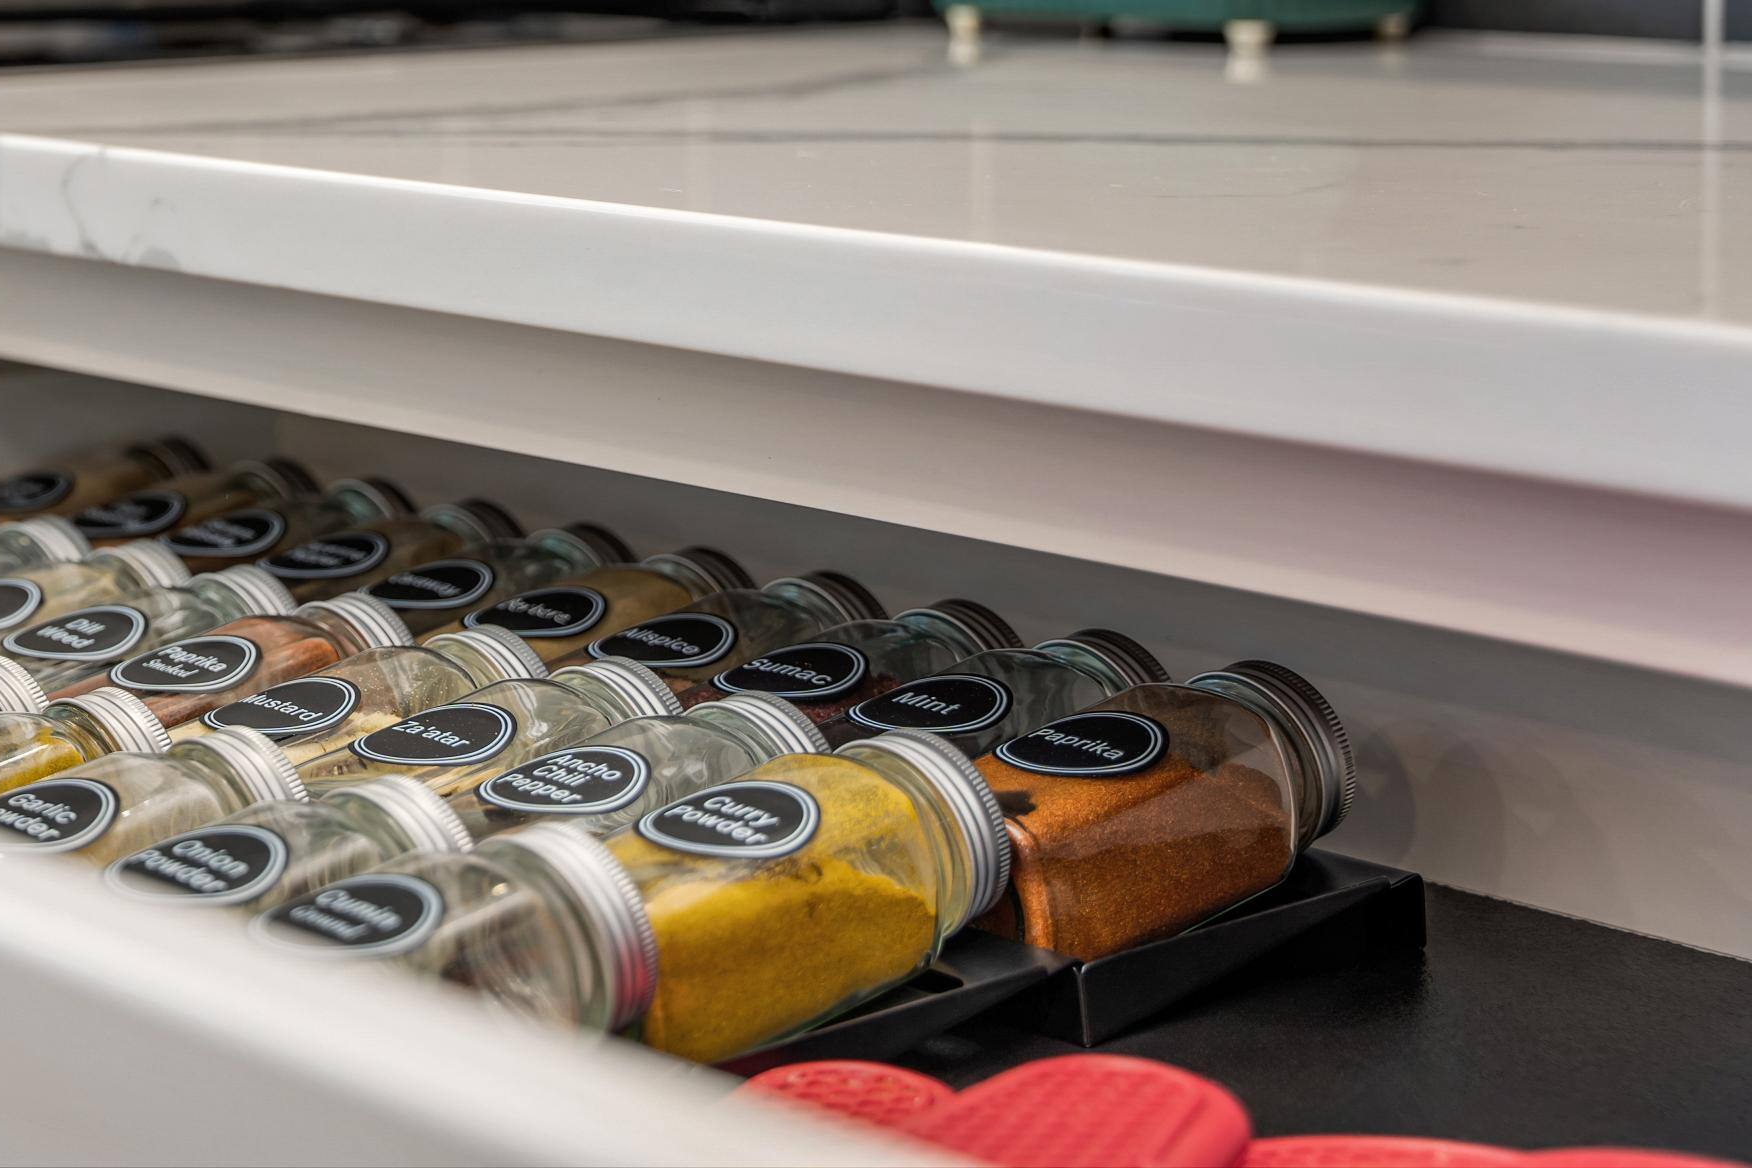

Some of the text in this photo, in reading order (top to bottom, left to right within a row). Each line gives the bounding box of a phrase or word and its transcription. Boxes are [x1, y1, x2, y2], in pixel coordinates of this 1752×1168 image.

[36, 626, 95, 649] Weed
[65, 618, 106, 635] Dill
[157, 646, 227, 672] Paprika
[743, 658, 832, 685] Sumac
[235, 693, 323, 722] Mustard
[891, 692, 961, 715] Mint
[391, 720, 470, 747] Za'atar
[1028, 728, 1125, 760] Paprika
[532, 765, 591, 786] Chili
[546, 754, 623, 781] Ancho
[496, 773, 584, 803] Pepper
[8, 793, 77, 824] Garlic
[703, 795, 780, 828] Curry
[664, 805, 770, 845] Powder
[172, 840, 249, 879] Onion
